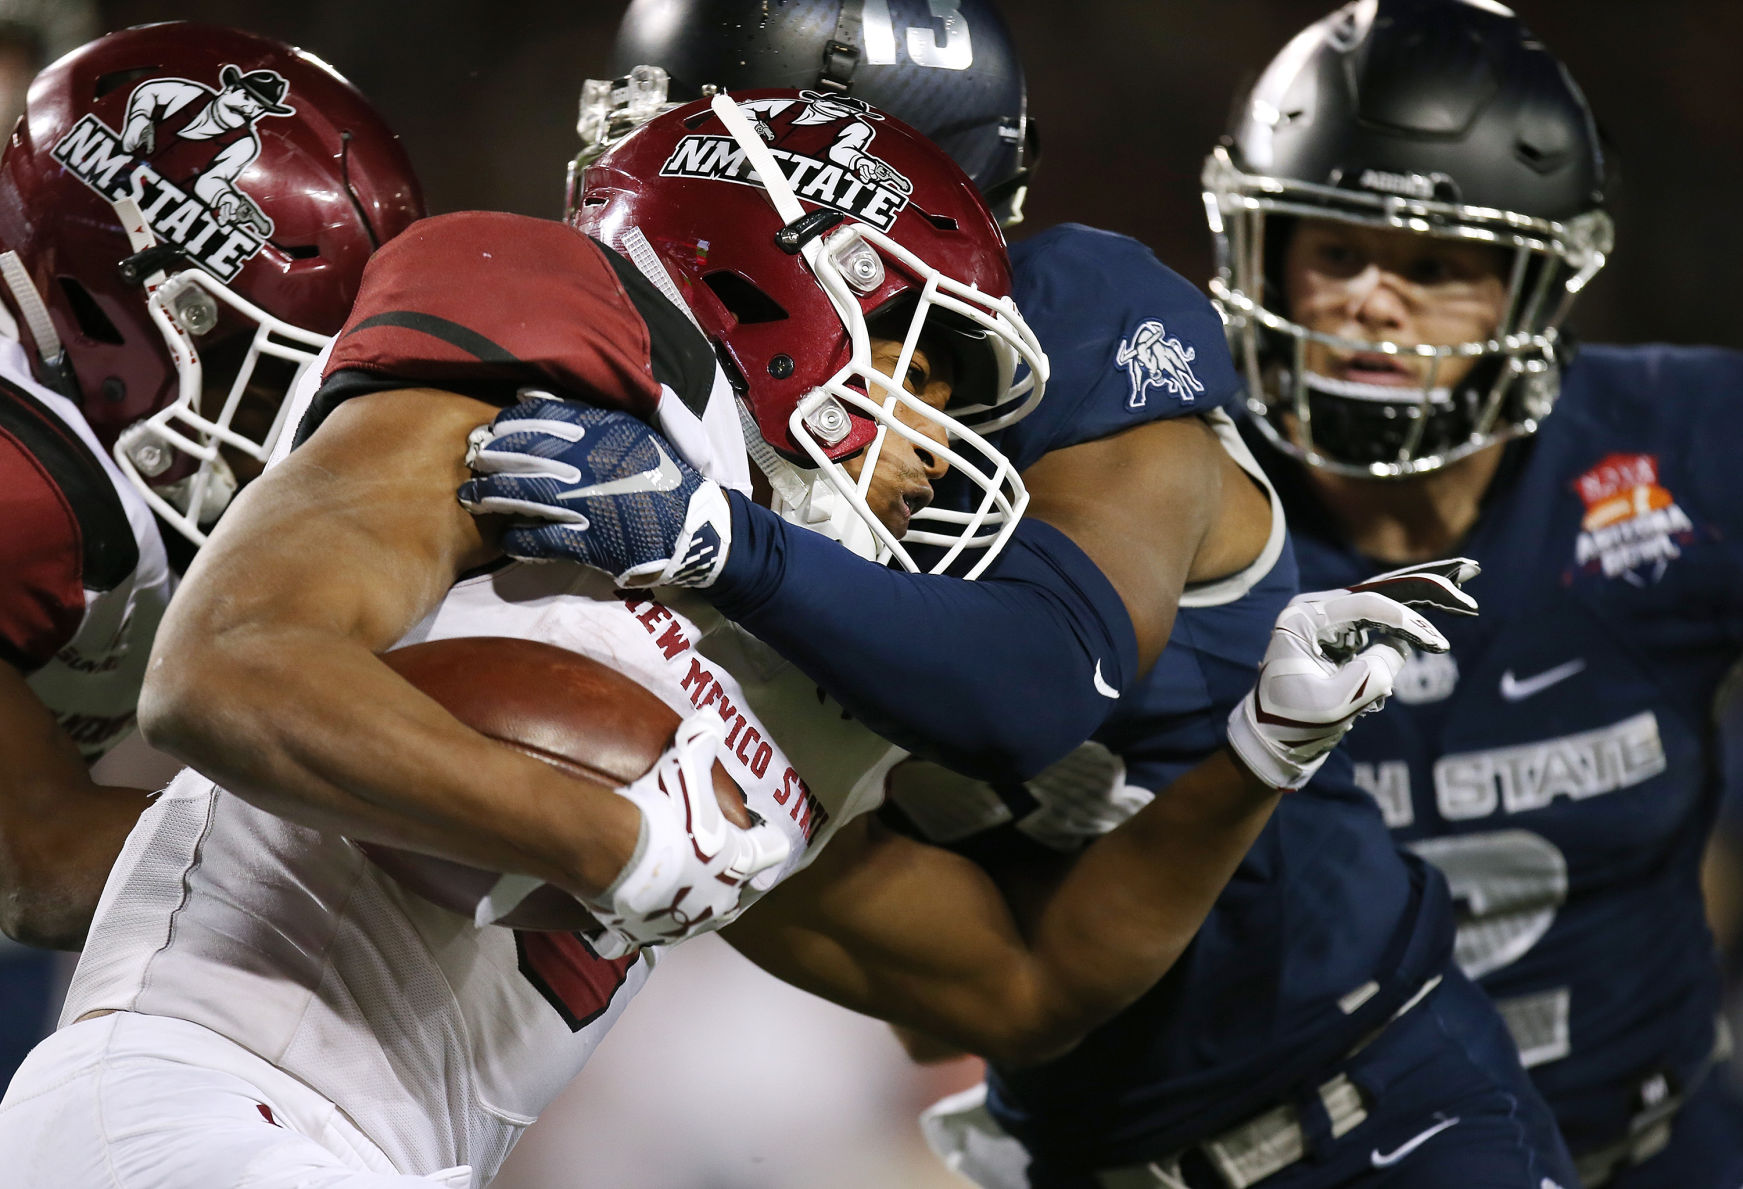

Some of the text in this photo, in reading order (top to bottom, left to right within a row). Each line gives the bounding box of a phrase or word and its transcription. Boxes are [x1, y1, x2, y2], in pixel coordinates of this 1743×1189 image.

[57, 121, 257, 277] NM STATE
[668, 139, 746, 177] NM
[1433, 709, 1667, 821] STATE
